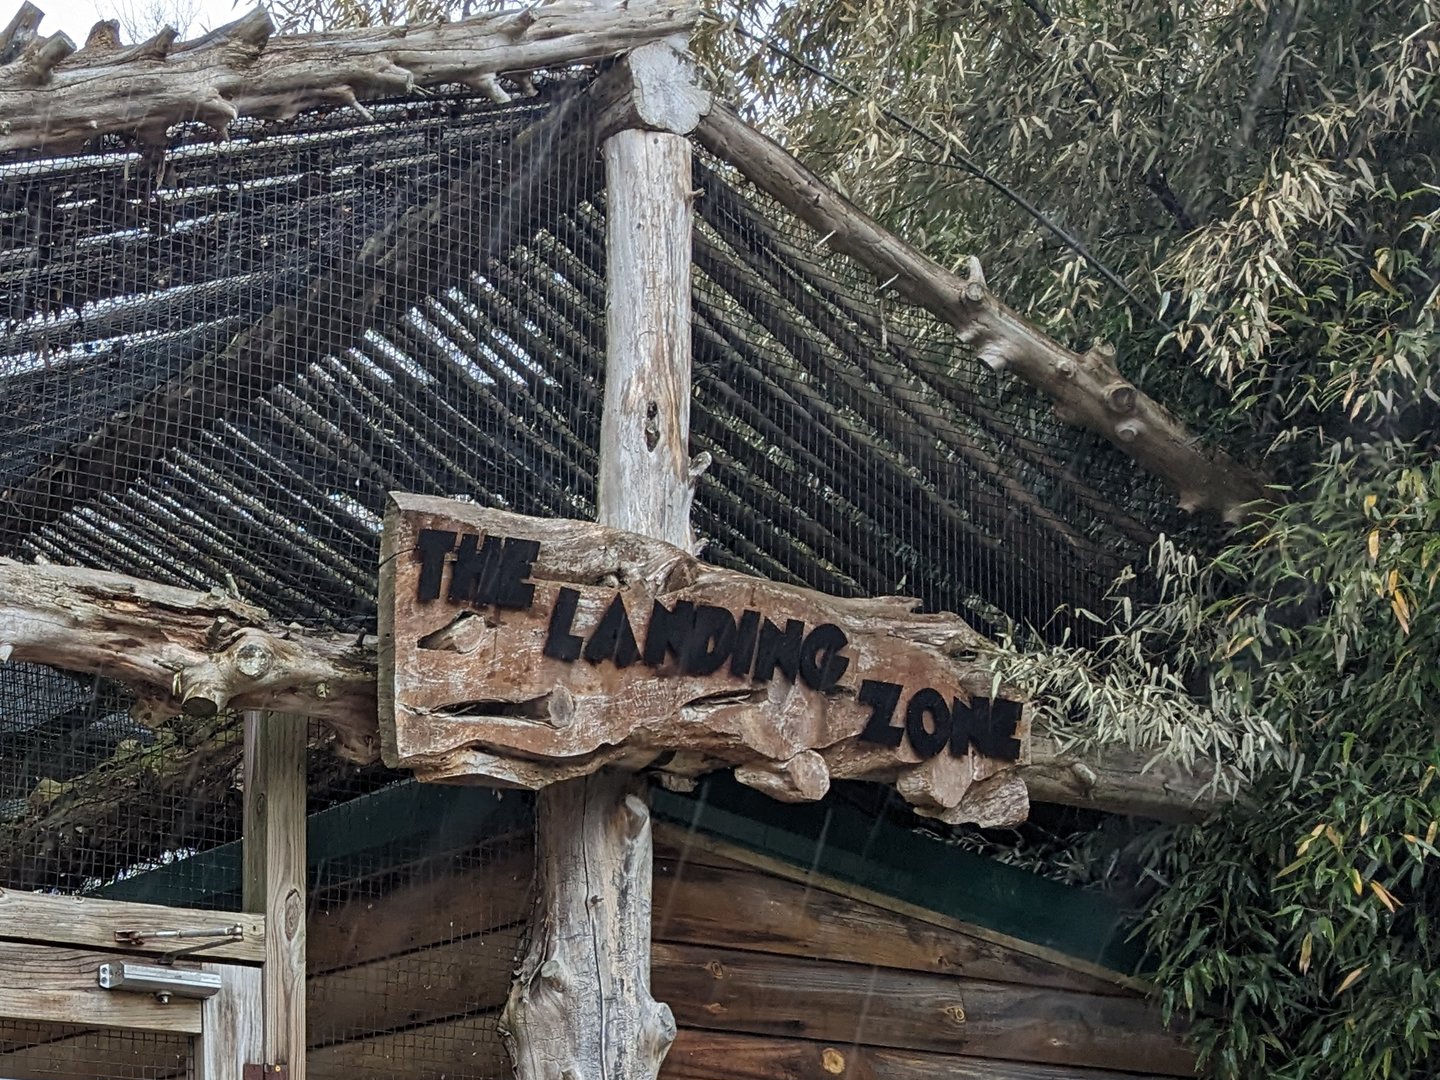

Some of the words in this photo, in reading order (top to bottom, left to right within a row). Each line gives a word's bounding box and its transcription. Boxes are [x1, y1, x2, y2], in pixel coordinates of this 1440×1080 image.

[416, 528, 540, 609] THE
[543, 587, 849, 691] LANDING
[858, 680, 1023, 761] ZONE
